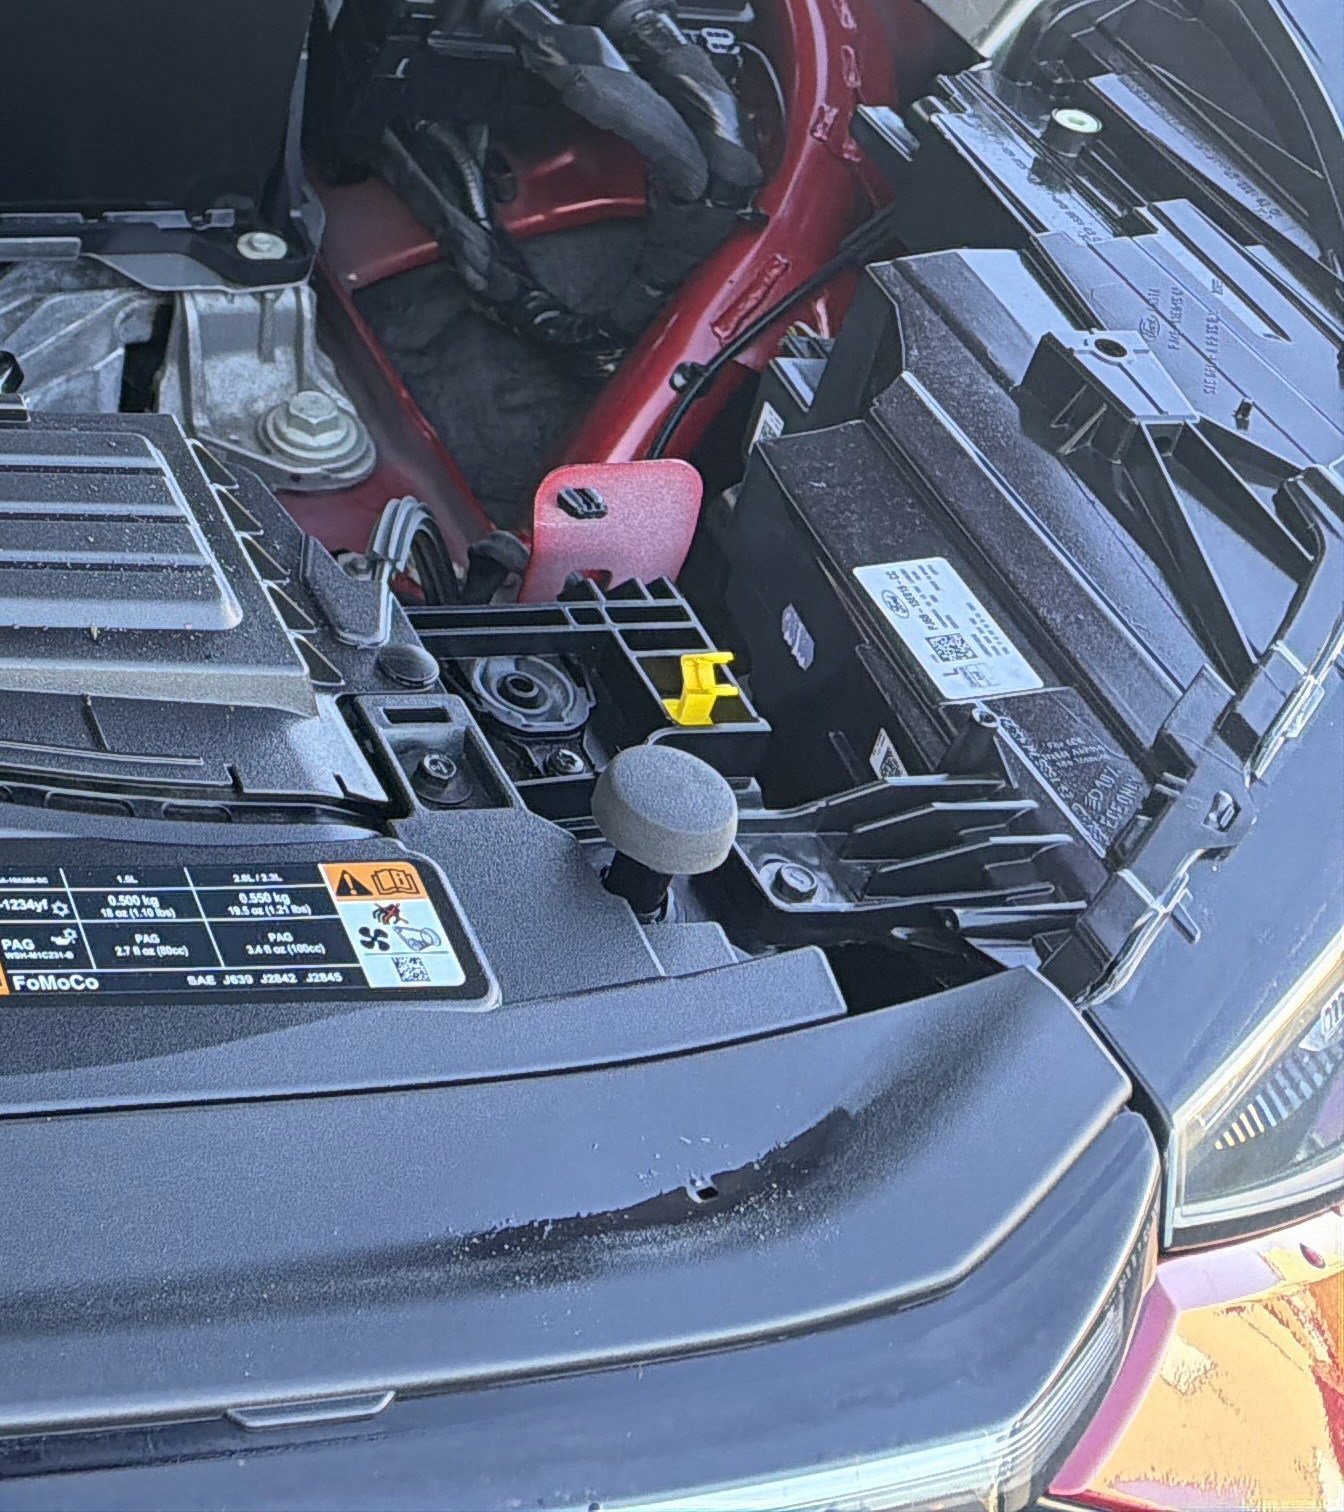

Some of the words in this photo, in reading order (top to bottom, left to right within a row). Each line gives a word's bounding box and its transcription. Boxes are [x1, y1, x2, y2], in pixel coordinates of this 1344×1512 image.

[107, 894, 140, 907] 0.500
[141, 894, 160, 908] kg
[238, 892, 271, 905] 0.550
[273, 892, 291, 906] kg
[100, 908, 112, 918] 18
[114, 909, 128, 918] oz
[227, 906, 250, 916] 19.5
[252, 906, 265, 916] oz
[134, 933, 161, 944] PAG
[267, 932, 294, 943] PAG
[1, 938, 35, 951] PAG
[245, 945, 261, 955] 3.4
[273, 946, 287, 955] oz
[114, 946, 130, 957] 2.7
[142, 947, 156, 956] oz
[11, 974, 100, 991] FoMoCo
[186, 975, 218, 986] SAE
[222, 974, 254, 985] J639
